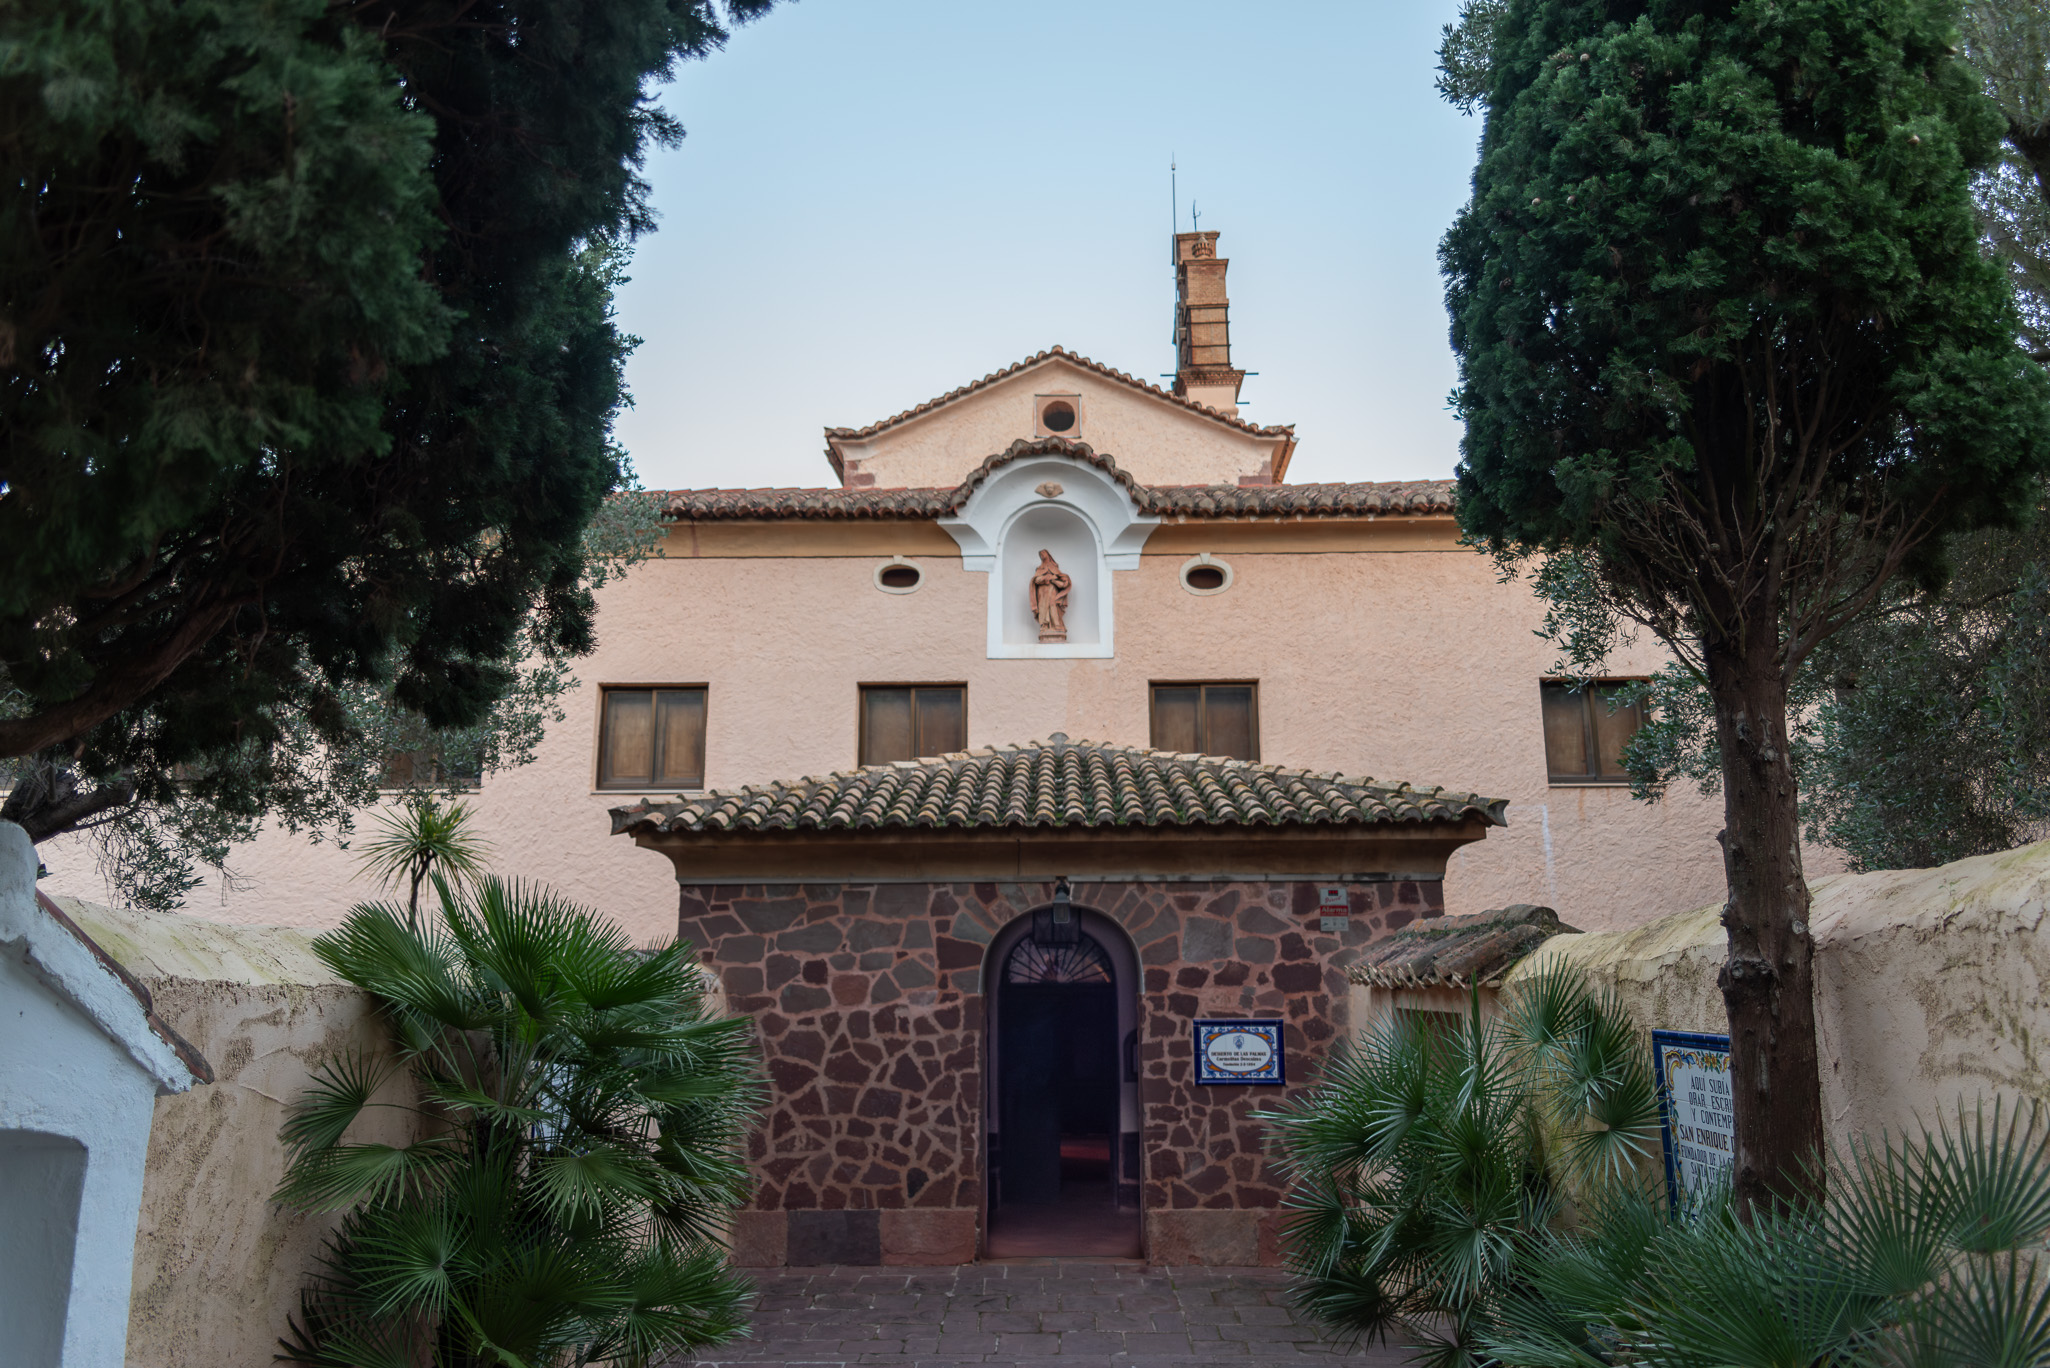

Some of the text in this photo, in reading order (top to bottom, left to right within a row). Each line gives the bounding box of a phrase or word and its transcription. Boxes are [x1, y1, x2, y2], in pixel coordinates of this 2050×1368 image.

[1690, 1074, 1730, 1096] AQUÍ SUBÍA
[1711, 1095, 1733, 1113] ESCRI
[1691, 1108, 1732, 1129] Y CONTEMP
[1679, 1123, 1694, 1142] SAN
[1696, 1128, 1729, 1152] ENRIQUE
[1680, 1144, 1707, 1164] FUNDADOR
[1708, 1151, 1716, 1167] DE
